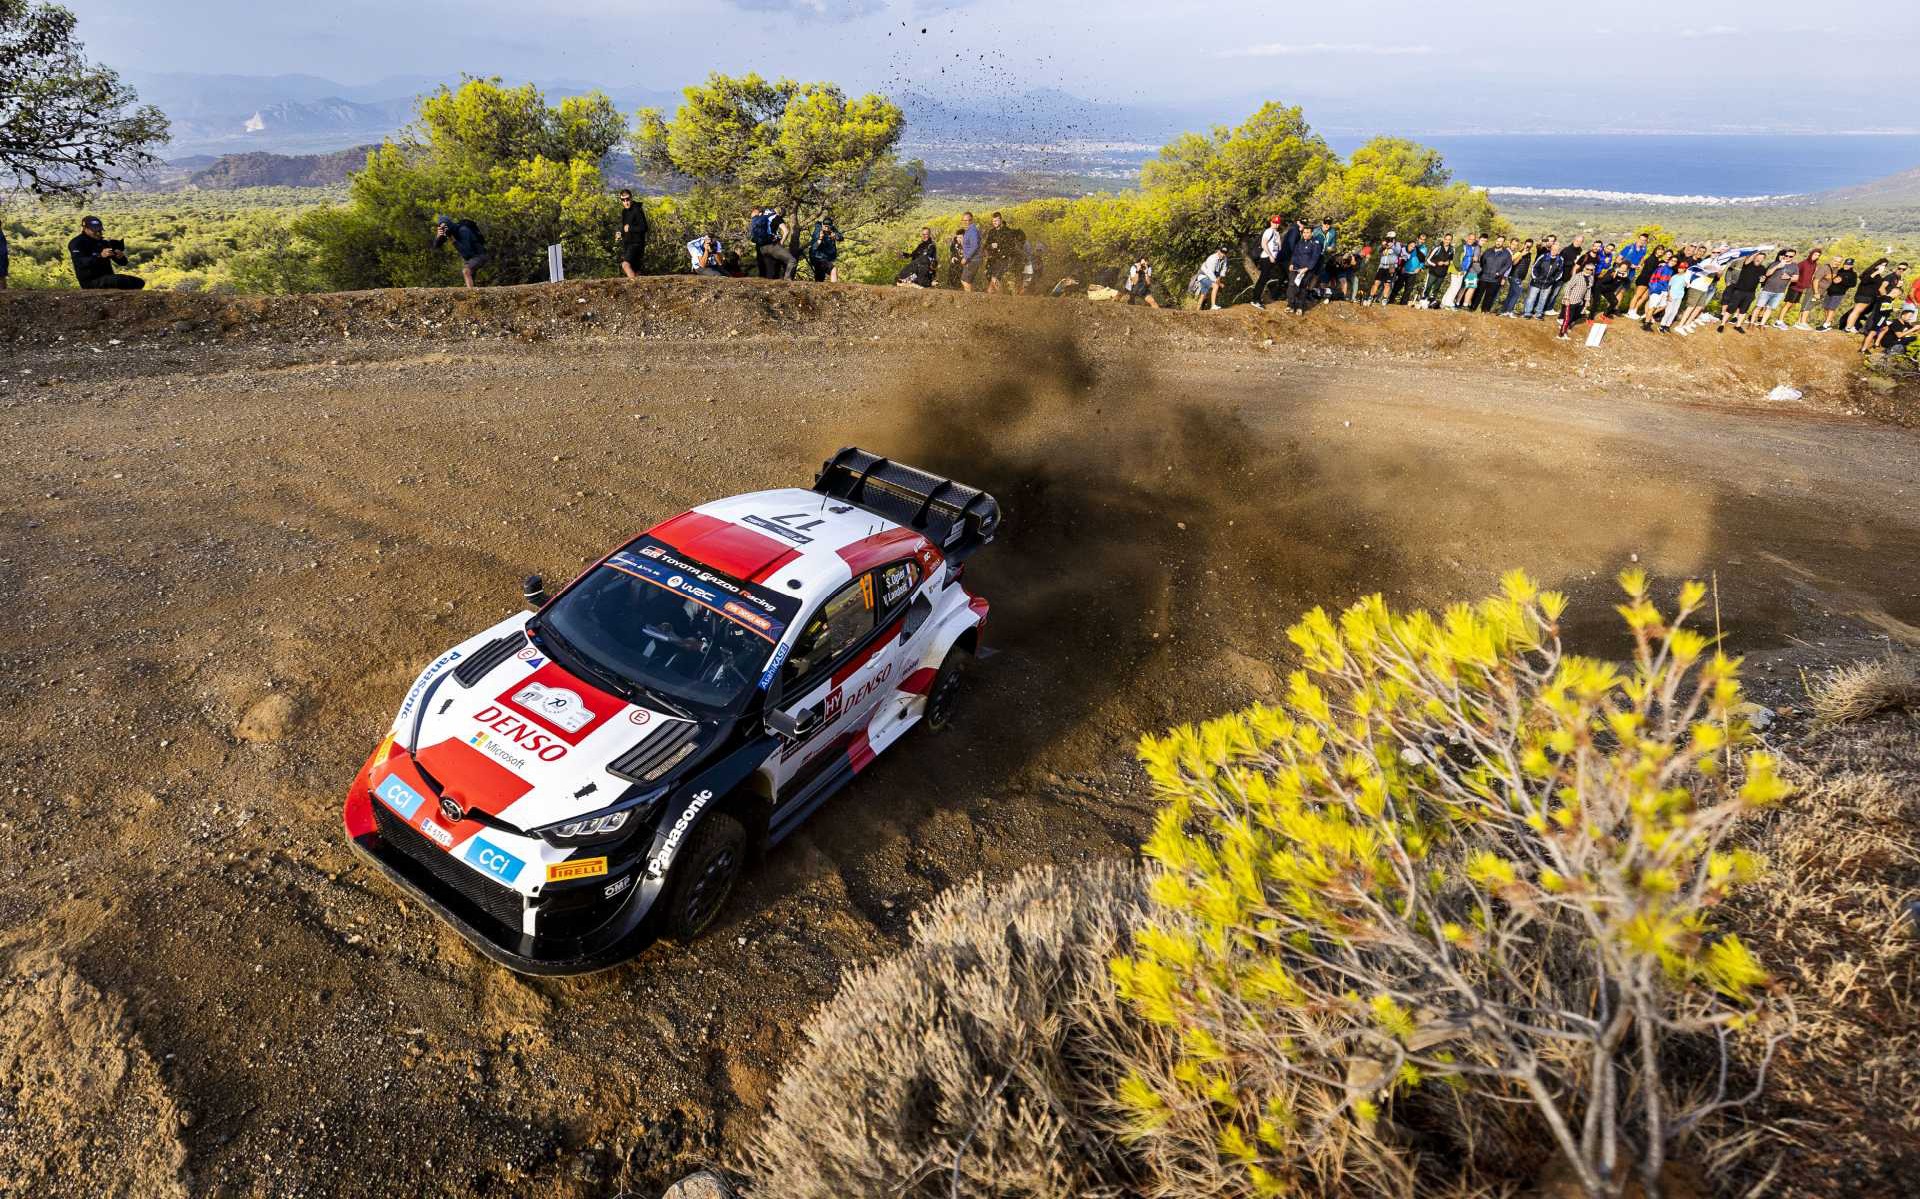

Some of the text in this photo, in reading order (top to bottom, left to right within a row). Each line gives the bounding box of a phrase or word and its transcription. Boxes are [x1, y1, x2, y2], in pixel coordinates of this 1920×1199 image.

[771, 514, 825, 531] 17
[661, 555, 700, 578] TOYOTA
[697, 571, 739, 594] GAZOO
[739, 590, 776, 612] Racing
[681, 582, 716, 601] WRC
[859, 572, 874, 611] 17
[401, 651, 462, 719] Panasonic
[761, 644, 788, 690] AsahiKASEI
[826, 691, 842, 715] HY
[843, 663, 892, 715] DENSO
[472, 706, 568, 762] DENSO
[485, 740, 527, 770] Microsoft
[648, 789, 713, 877] Panasonic
[550, 860, 603, 878] PIRELLI
[605, 877, 631, 897] OMP
